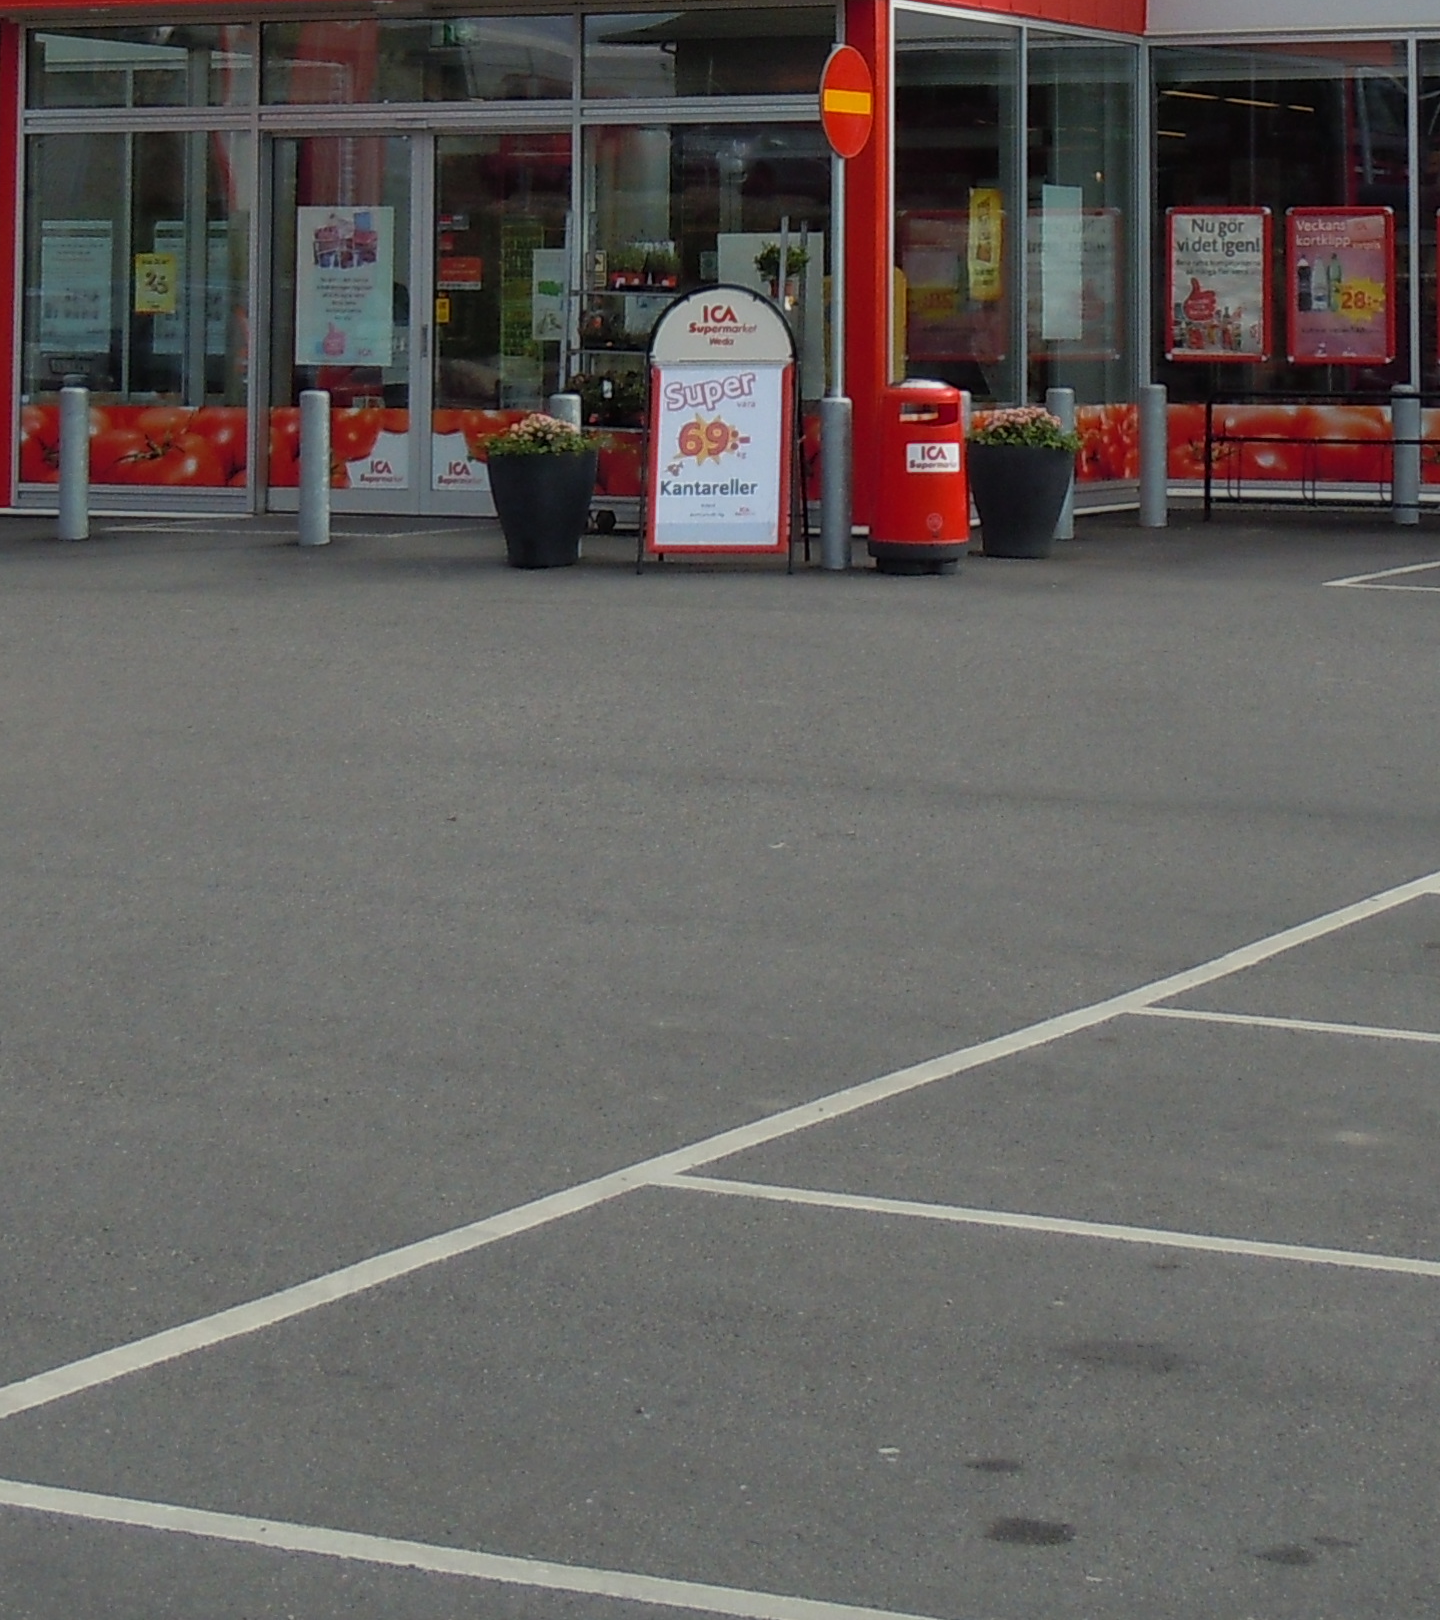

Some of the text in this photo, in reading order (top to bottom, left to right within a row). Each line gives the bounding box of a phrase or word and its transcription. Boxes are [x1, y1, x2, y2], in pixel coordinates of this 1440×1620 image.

[1190, 218, 1246, 240] Nu gör
[1295, 219, 1348, 232] Veckans
[1177, 237, 1260, 257] vi det igen!
[1295, 234, 1352, 248] kortklipp
[702, 304, 738, 323] ICA
[689, 322, 757, 335] Supermarket
[664, 372, 756, 412] Super
[921, 445, 948, 460] ICA
[370, 460, 392, 474] ICA
[448, 461, 471, 476] ICA
[660, 478, 758, 496] Kantareller
